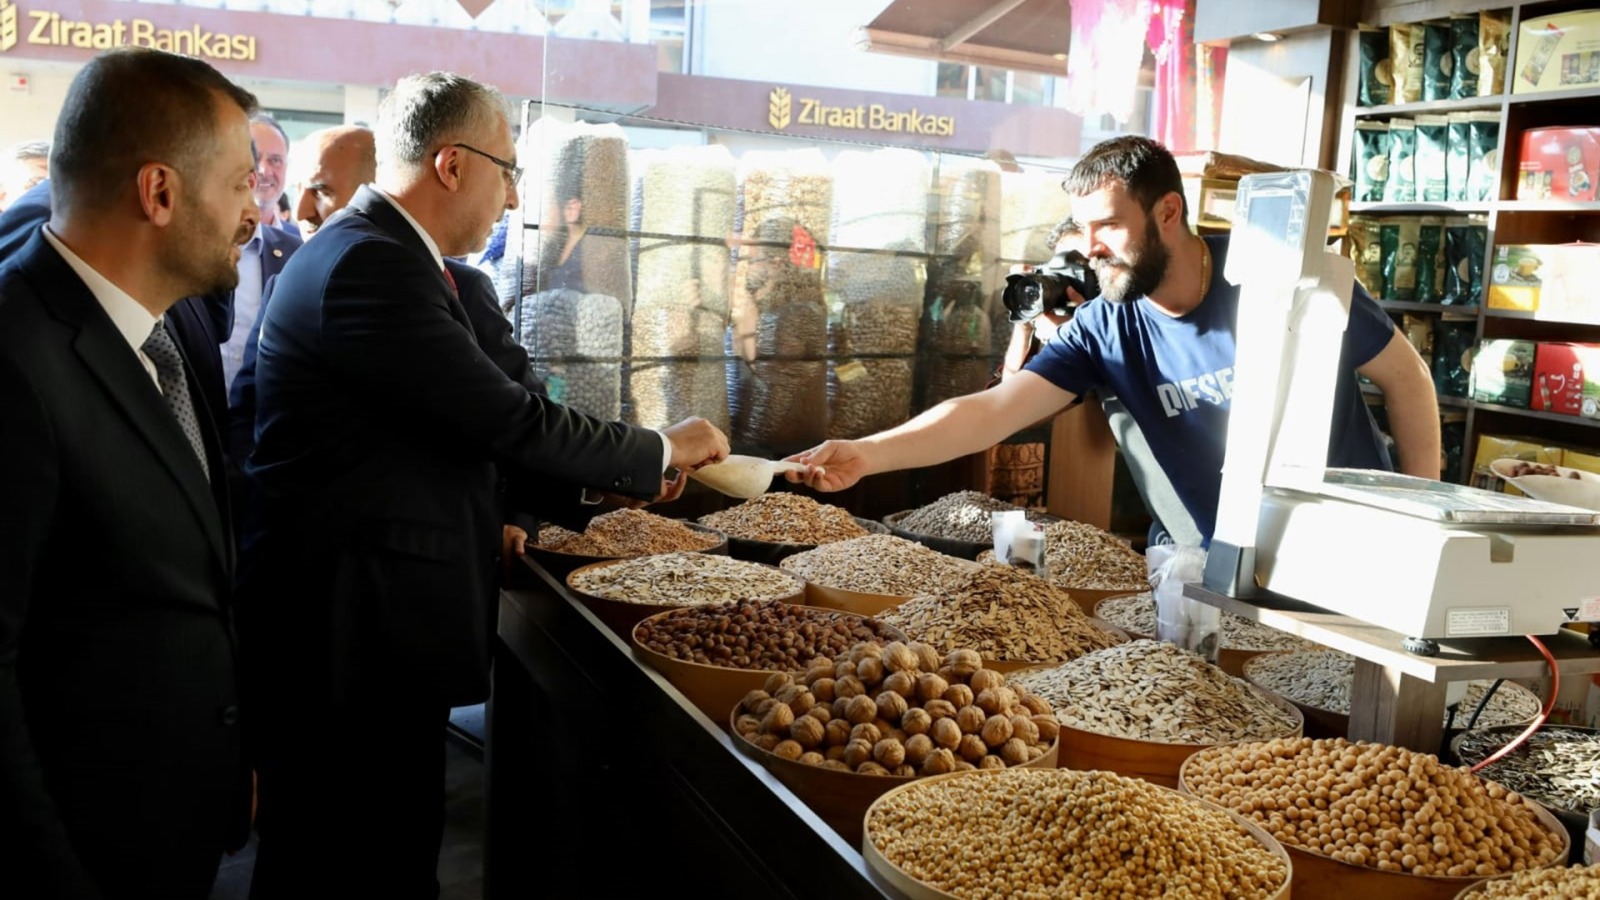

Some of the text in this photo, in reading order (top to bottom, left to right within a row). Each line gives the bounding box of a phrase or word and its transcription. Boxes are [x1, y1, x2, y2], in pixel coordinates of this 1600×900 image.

[28, 10, 256, 60] Ziraat Bankası
[798, 99, 955, 135] Ziraat Bankası
[1156, 366, 1235, 418] DIESE
